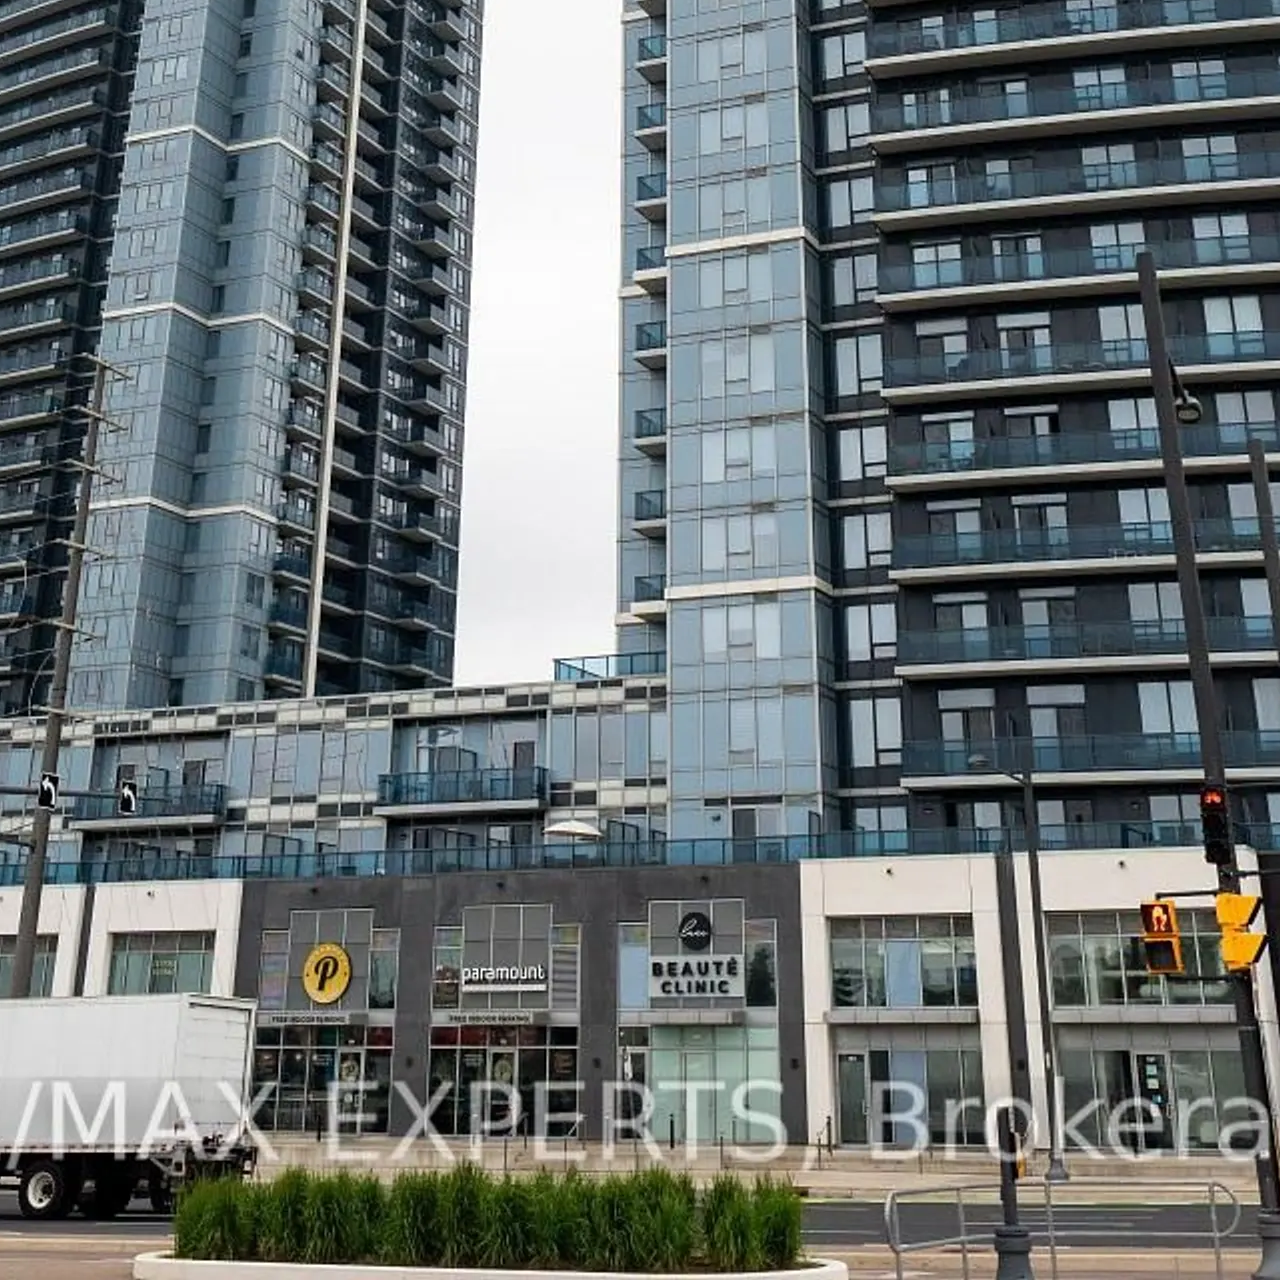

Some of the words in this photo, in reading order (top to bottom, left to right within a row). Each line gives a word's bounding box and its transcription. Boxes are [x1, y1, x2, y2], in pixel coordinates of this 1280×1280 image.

[462, 964, 545, 985] paramount
[651, 956, 738, 977] BEAUTÉ
[661, 980, 730, 994] CLINIC
